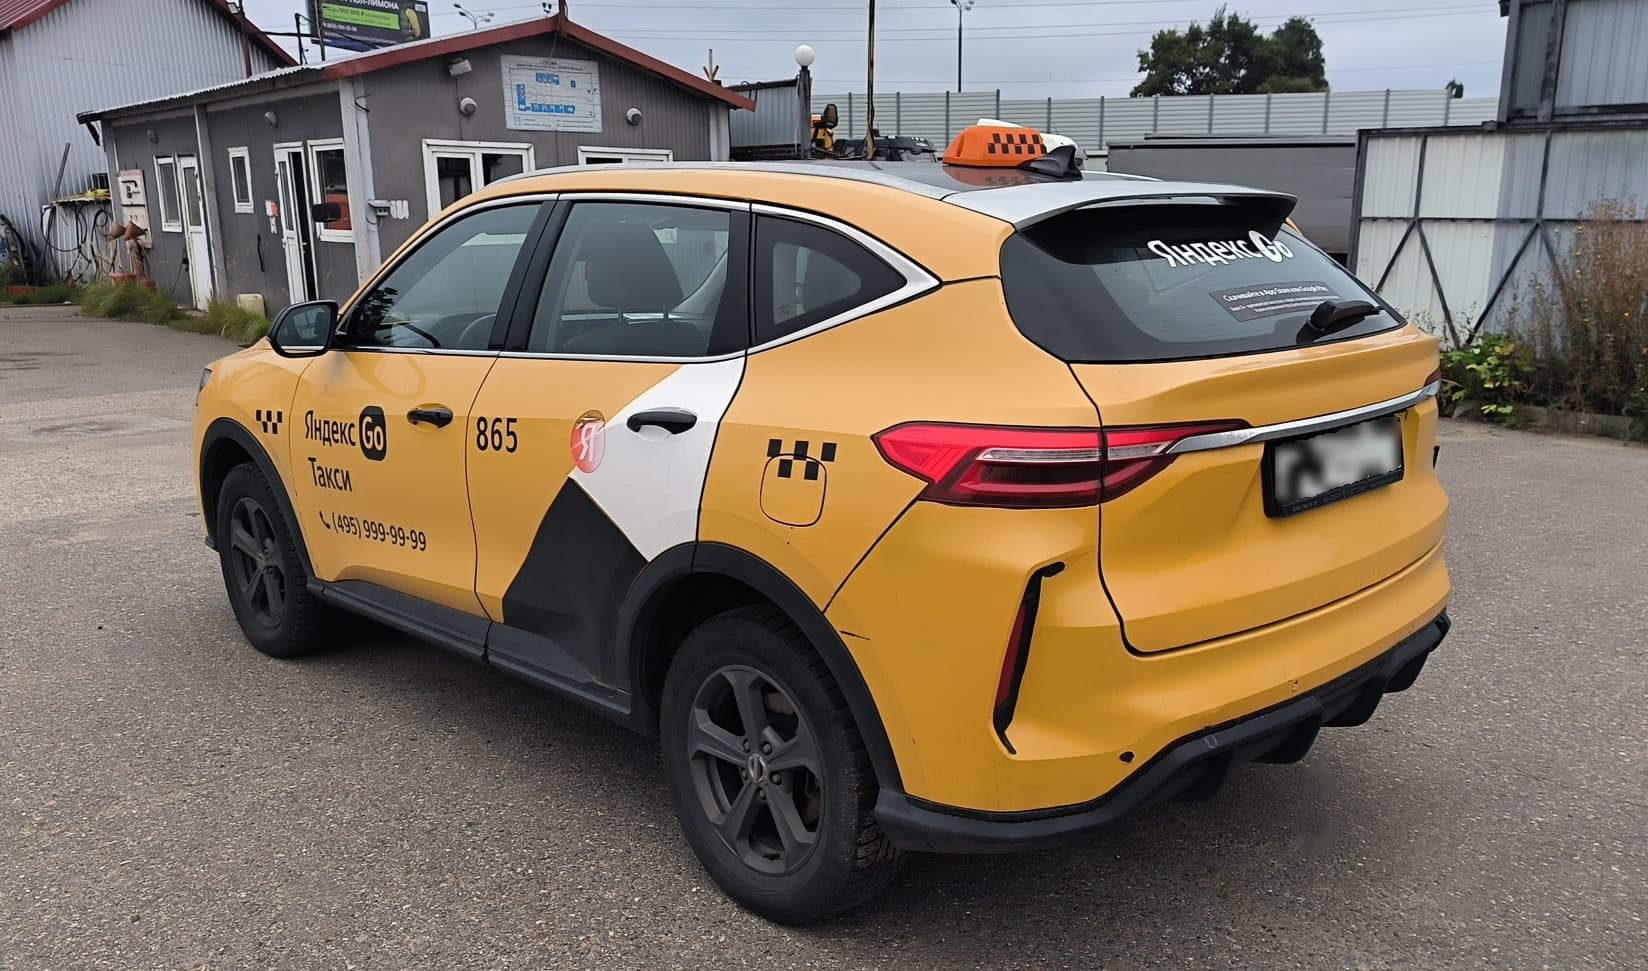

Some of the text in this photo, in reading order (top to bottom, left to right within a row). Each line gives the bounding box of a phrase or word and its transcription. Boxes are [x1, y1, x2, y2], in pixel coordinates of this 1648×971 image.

[1147, 230, 1294, 267] Яндекс Go
[305, 410, 384, 451] Яндекс Go
[476, 416, 518, 453] 865
[578, 422, 599, 462] Я
[308, 457, 353, 492] Такси
[332, 512, 427, 551] (495) 999-99-99
